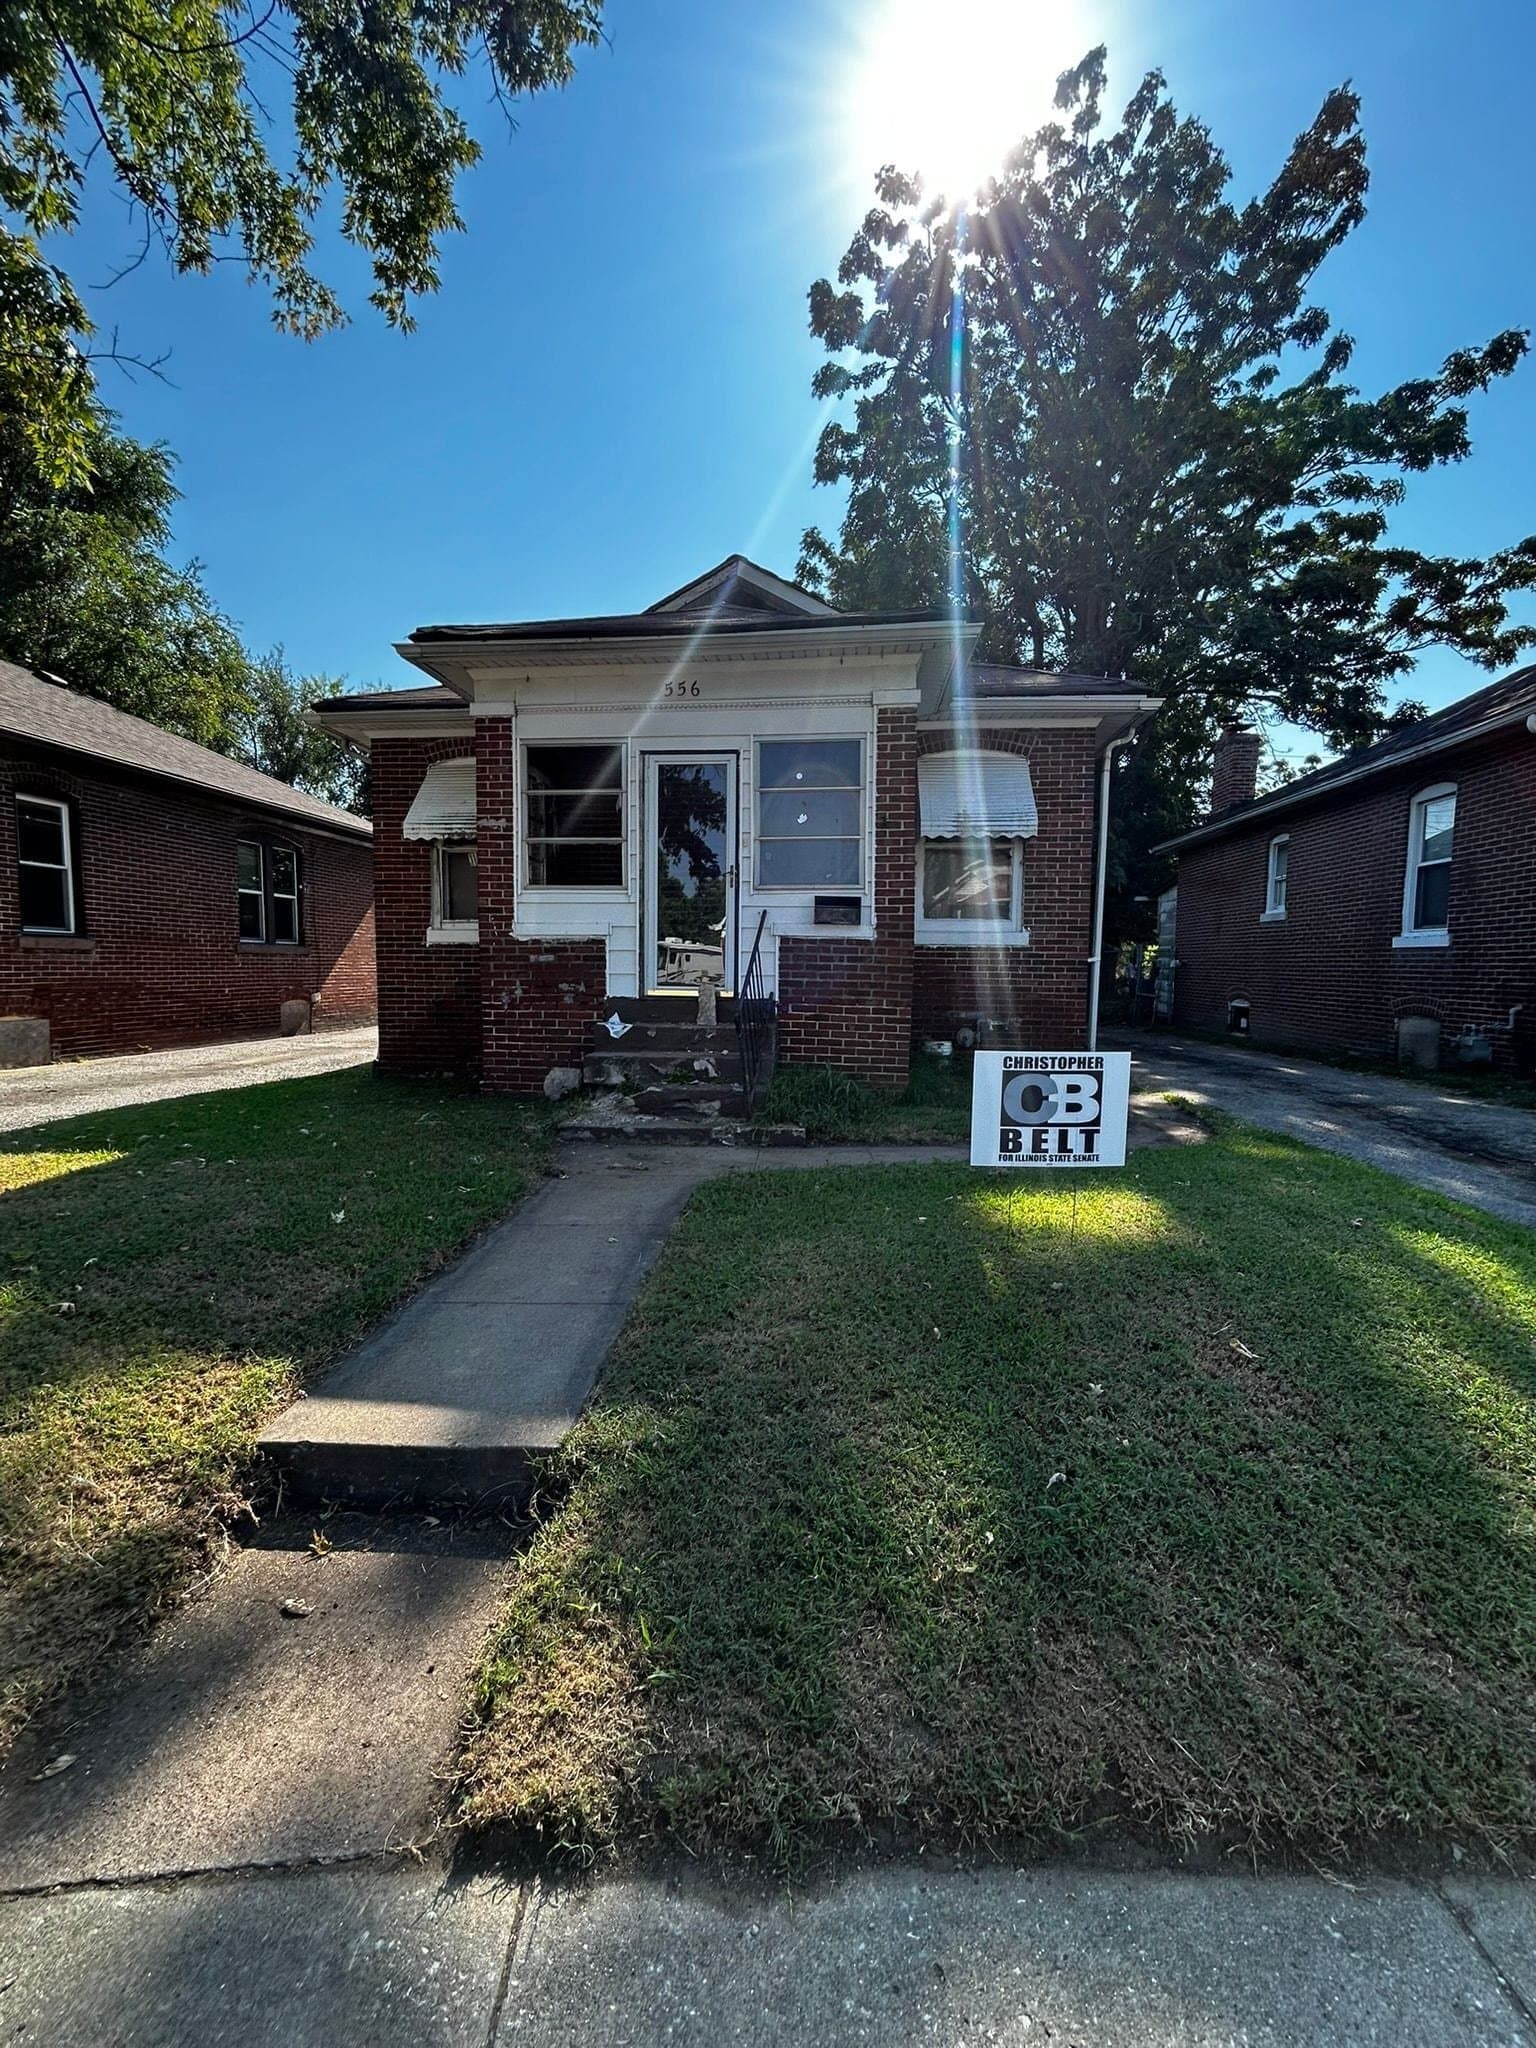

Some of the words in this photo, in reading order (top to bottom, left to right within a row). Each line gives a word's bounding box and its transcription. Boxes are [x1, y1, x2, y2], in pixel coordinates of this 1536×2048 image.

[664, 680, 700, 697] 556
[1003, 1056, 1104, 1070] CHRISTOPHER
[1003, 1073, 1100, 1125] CB
[1000, 1128, 1101, 1154] BELT
[998, 1154, 1013, 1162] FOR
[1015, 1154, 1047, 1162] ILLINOIS
[1047, 1154, 1071, 1162] STATE
[1072, 1154, 1100, 1162] SENATE
